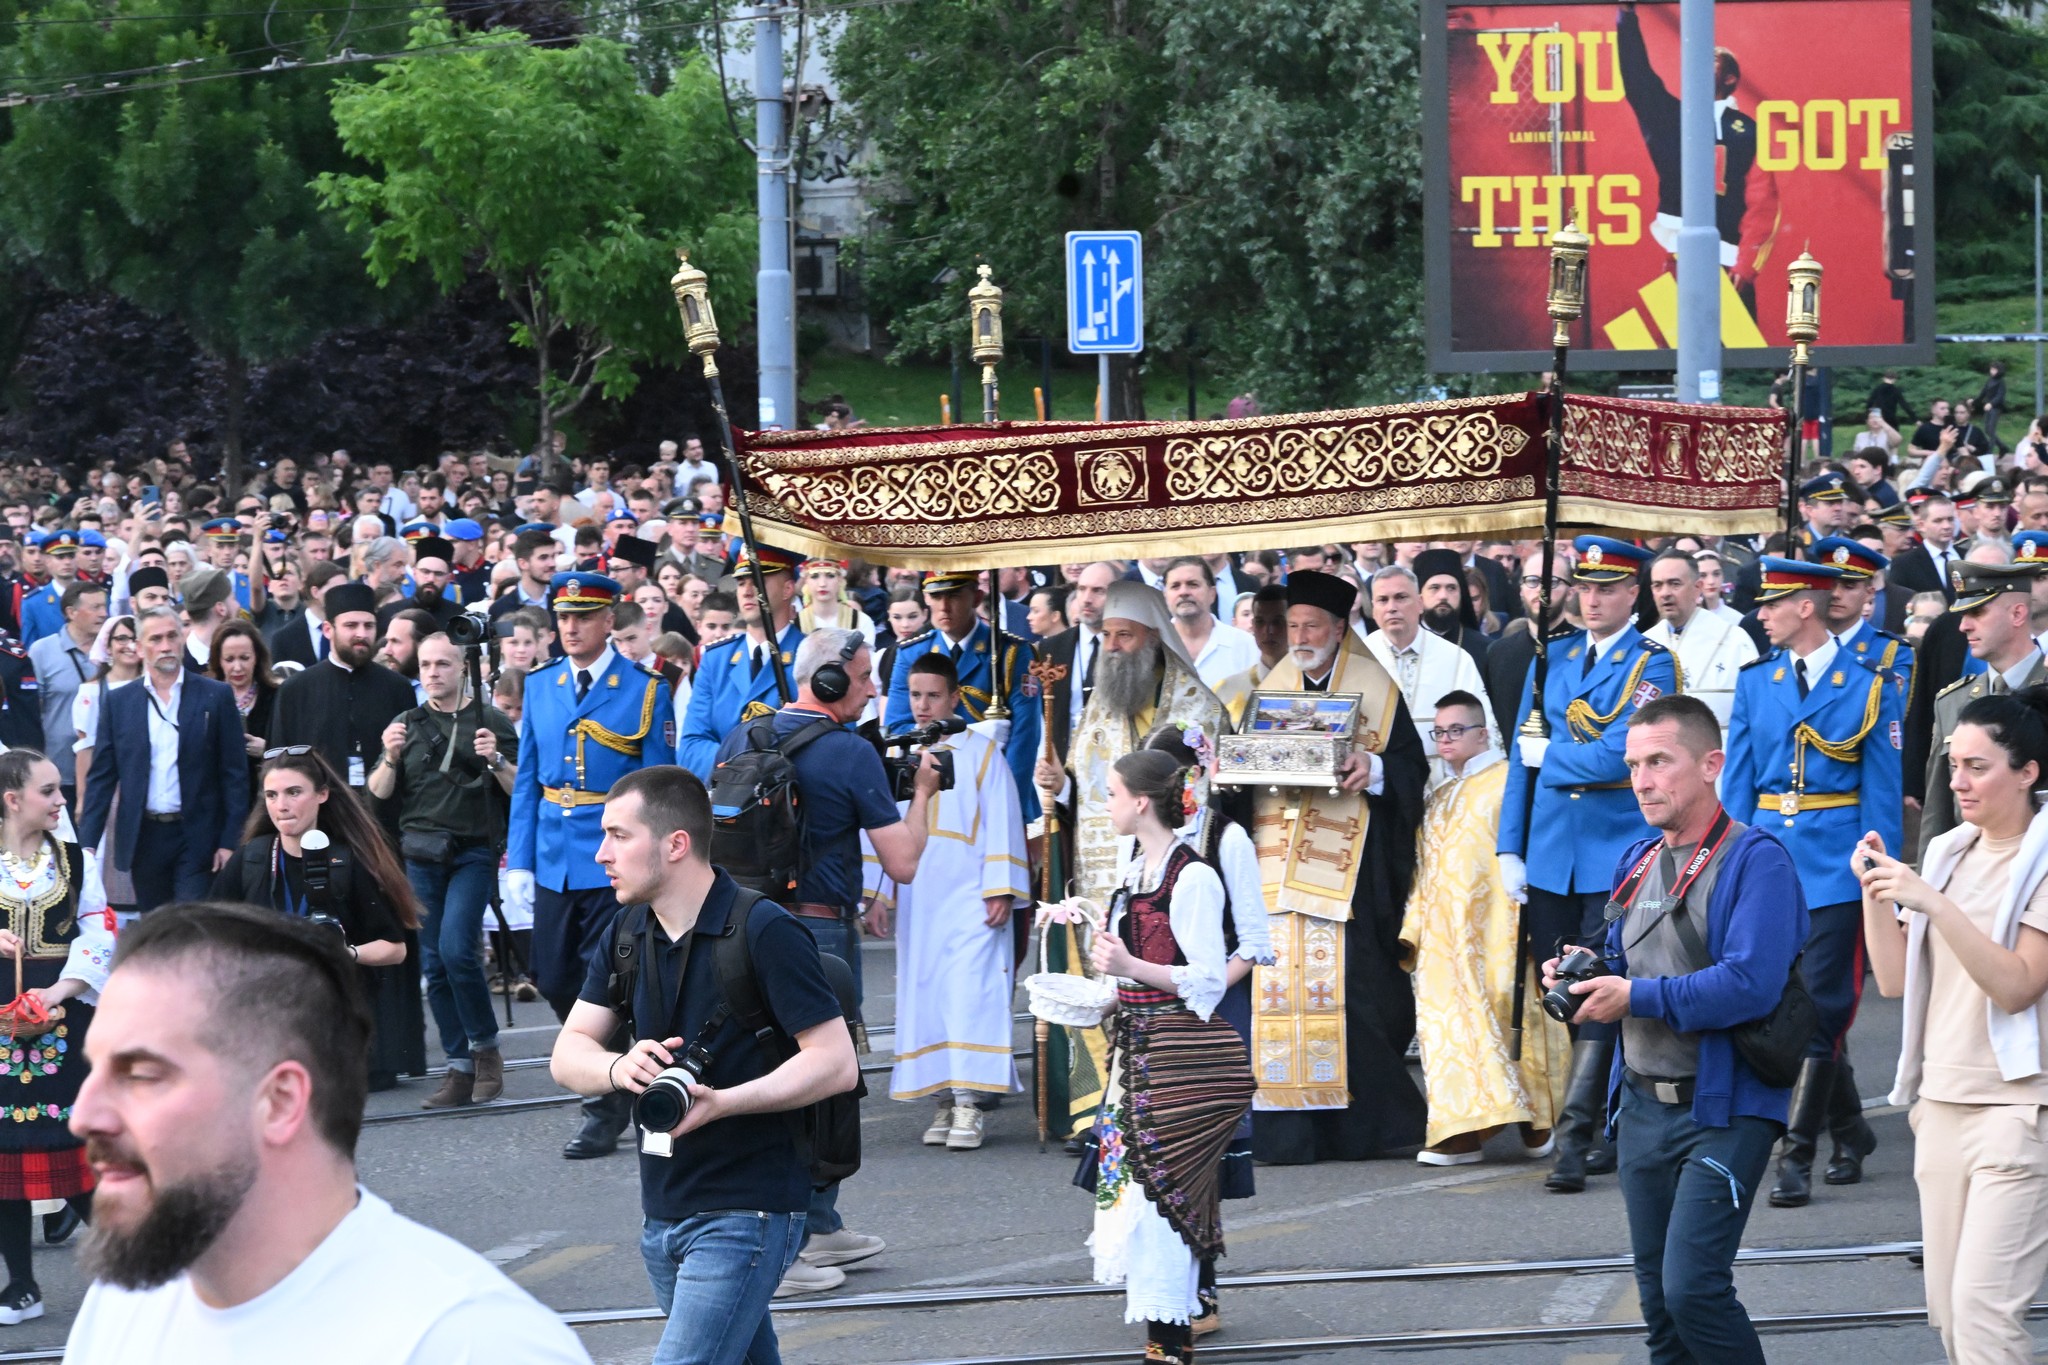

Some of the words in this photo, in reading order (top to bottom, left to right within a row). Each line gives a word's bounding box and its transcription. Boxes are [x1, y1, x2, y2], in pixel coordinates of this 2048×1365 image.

[1477, 31, 1626, 103] YOU
[1509, 131, 1554, 143] LAMINE
[1557, 130, 1597, 142] YAMAL
[1756, 98, 1900, 172] GOT
[1461, 174, 1642, 247] THIS
[1632, 850, 1656, 879] DIGITAL
[1686, 848, 1710, 875] Canon
